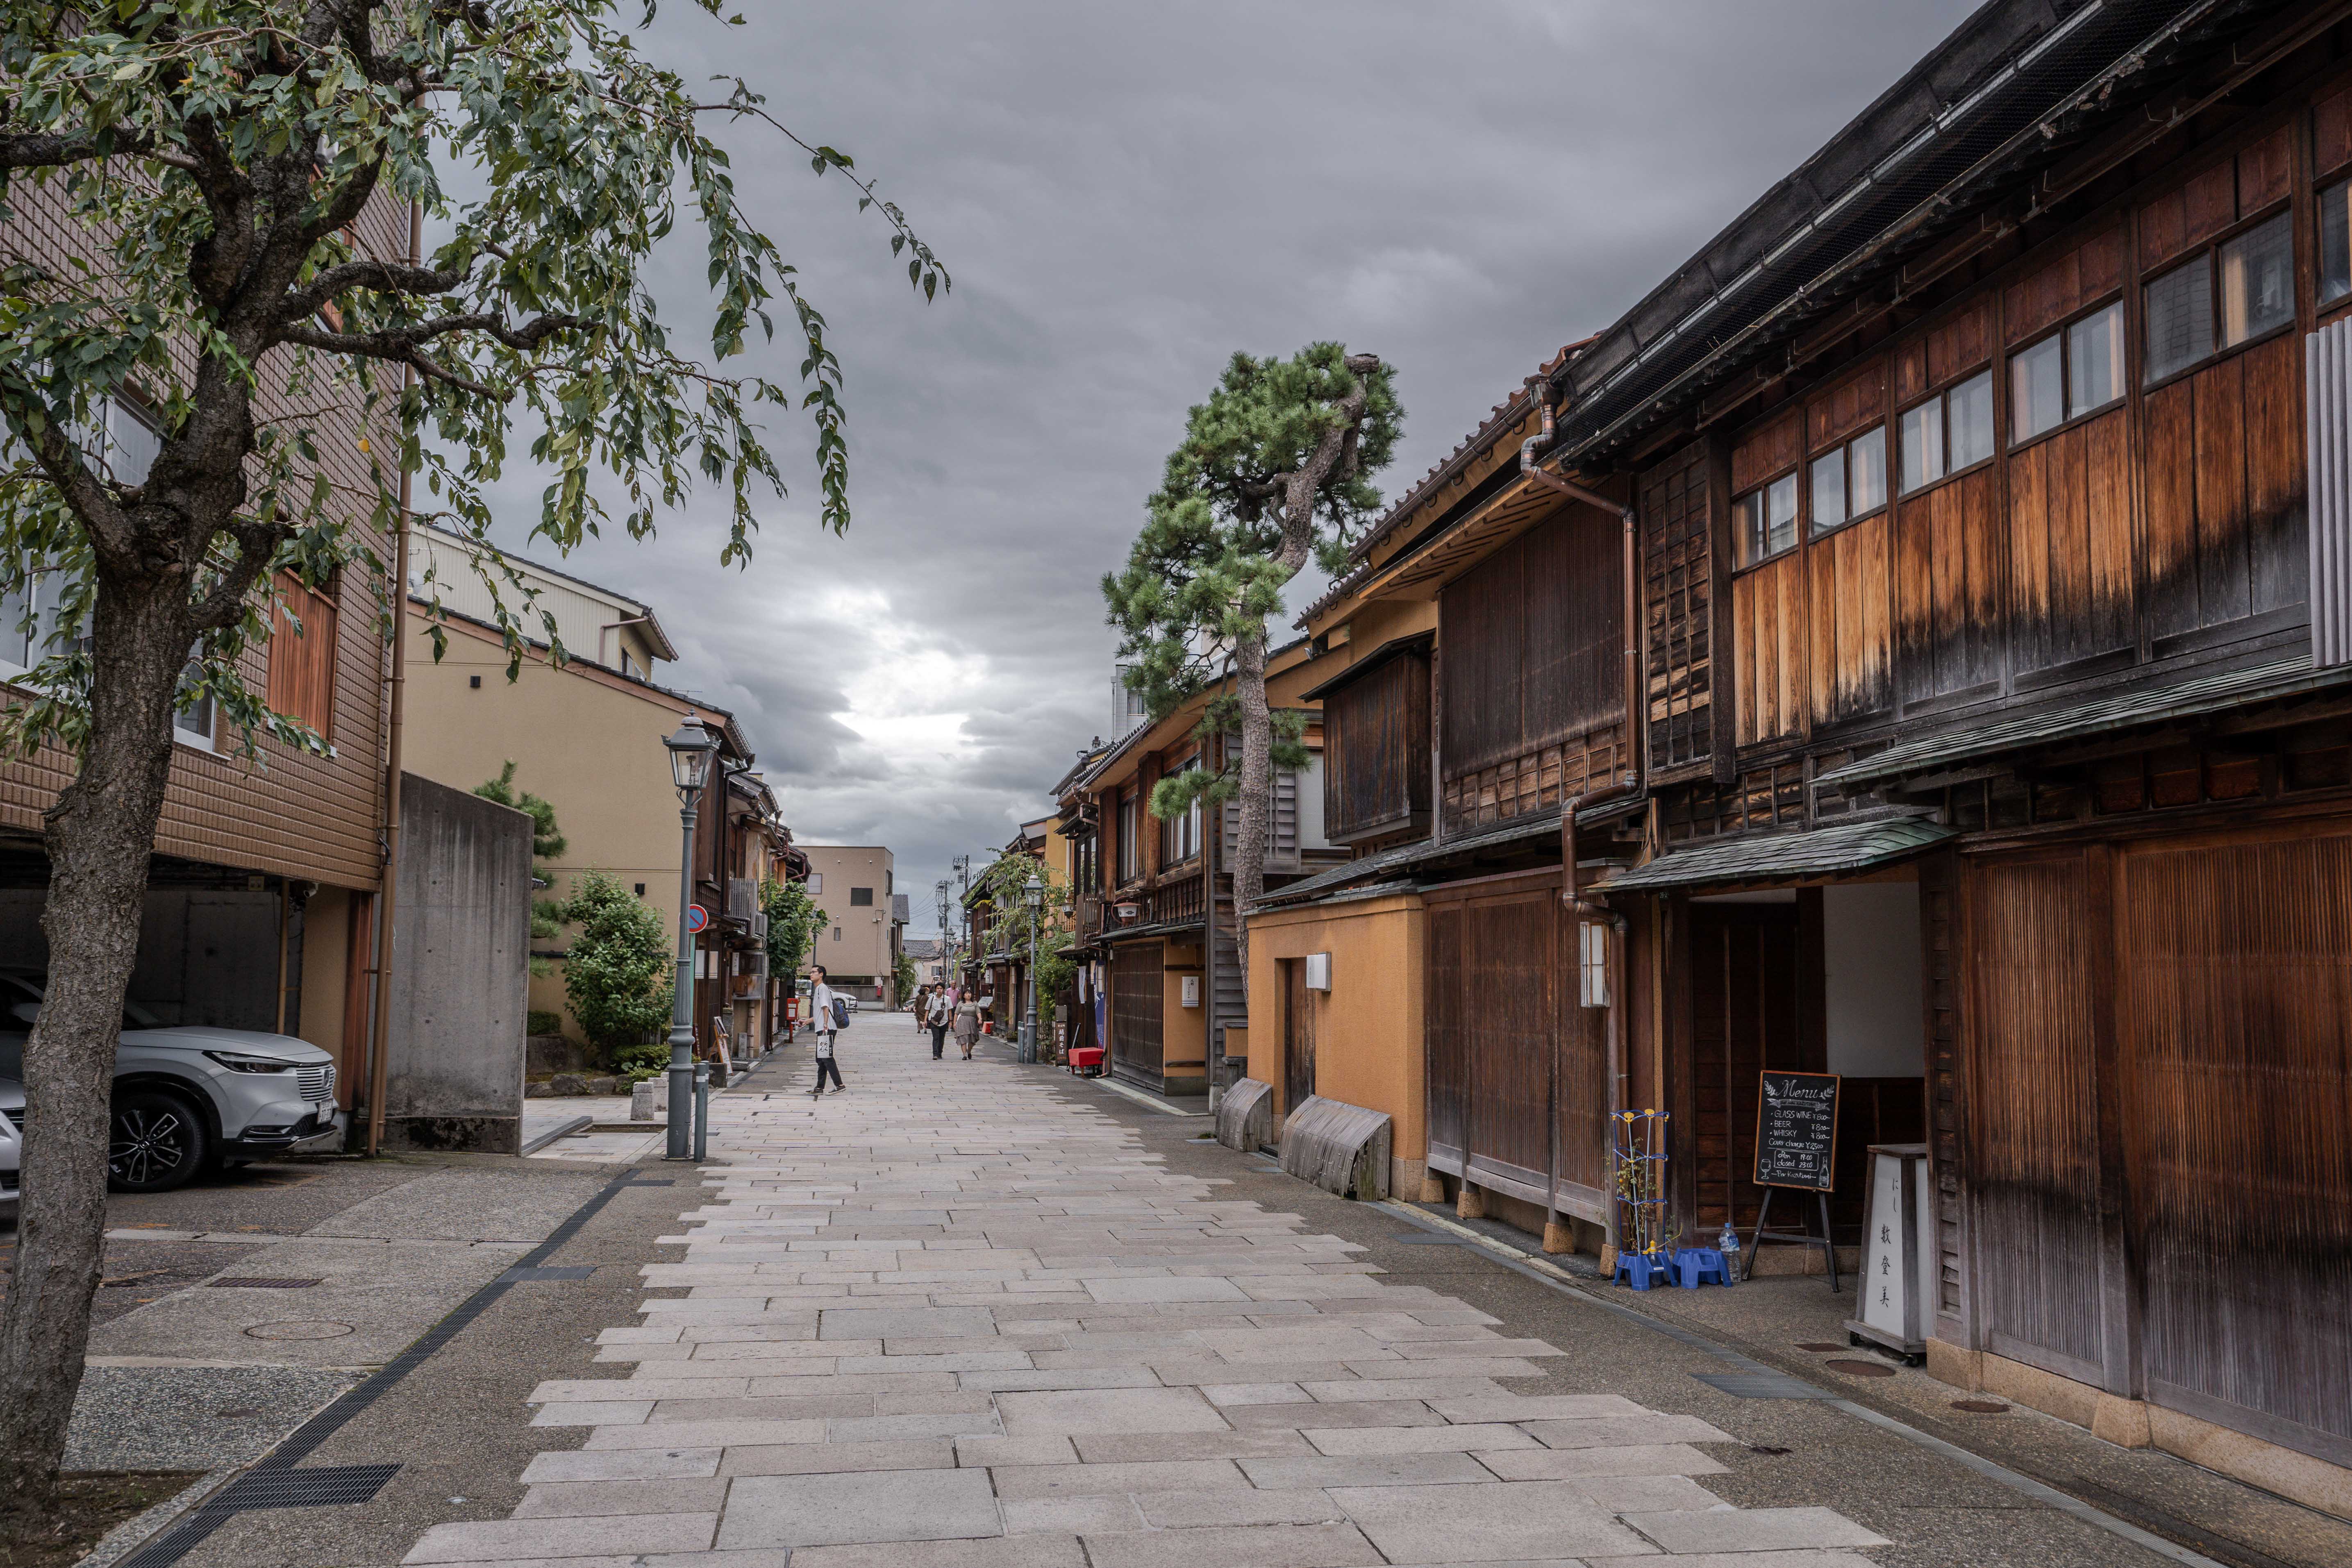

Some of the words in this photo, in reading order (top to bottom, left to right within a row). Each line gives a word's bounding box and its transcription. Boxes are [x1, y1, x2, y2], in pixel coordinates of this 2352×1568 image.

[1777, 1079, 1818, 1098] Menu
[1775, 1110, 1795, 1118] GLASS
[1773, 1129, 1797, 1138] WHISKY
[1785, 1140, 1804, 1149] charge
[1892, 1178, 1899, 1213] にし
[1879, 1223, 1891, 1308] 数登美
